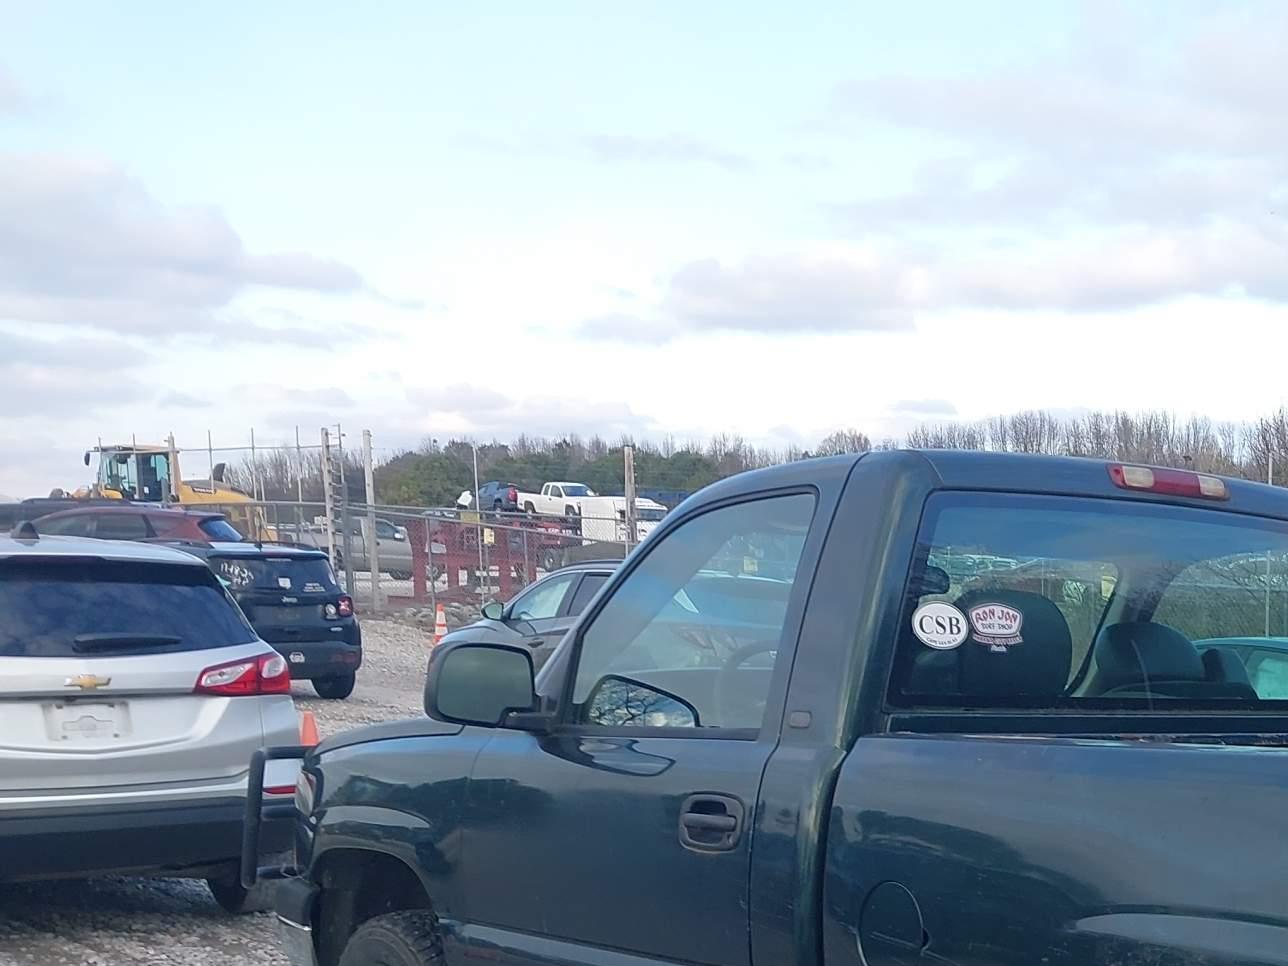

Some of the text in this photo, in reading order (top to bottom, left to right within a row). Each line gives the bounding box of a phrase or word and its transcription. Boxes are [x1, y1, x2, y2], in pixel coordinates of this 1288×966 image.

[919, 615, 962, 636] CSB
[975, 608, 1018, 625] RON JON
